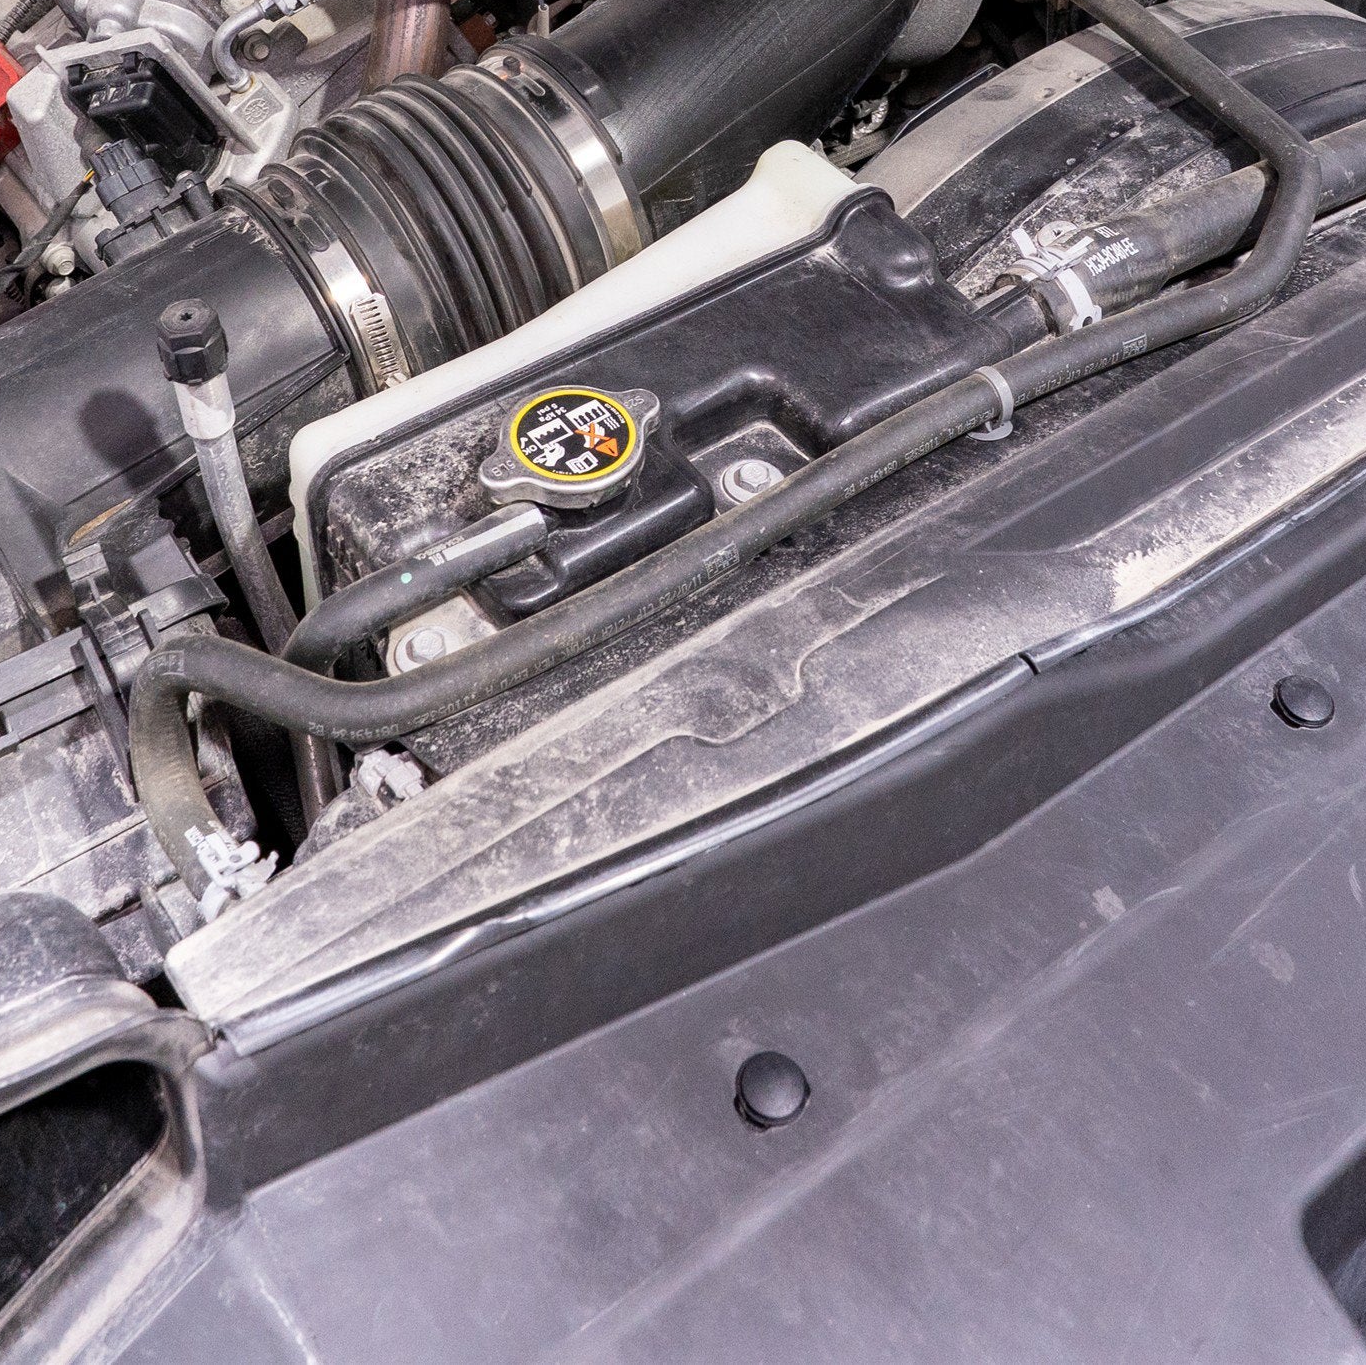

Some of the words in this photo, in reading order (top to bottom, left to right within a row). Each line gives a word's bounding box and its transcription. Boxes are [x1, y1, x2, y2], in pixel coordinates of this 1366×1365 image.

[535, 404, 550, 416] psi
[554, 404, 567, 415] 34
[537, 410, 556, 424] kPa
[521, 443, 537, 456] OK
